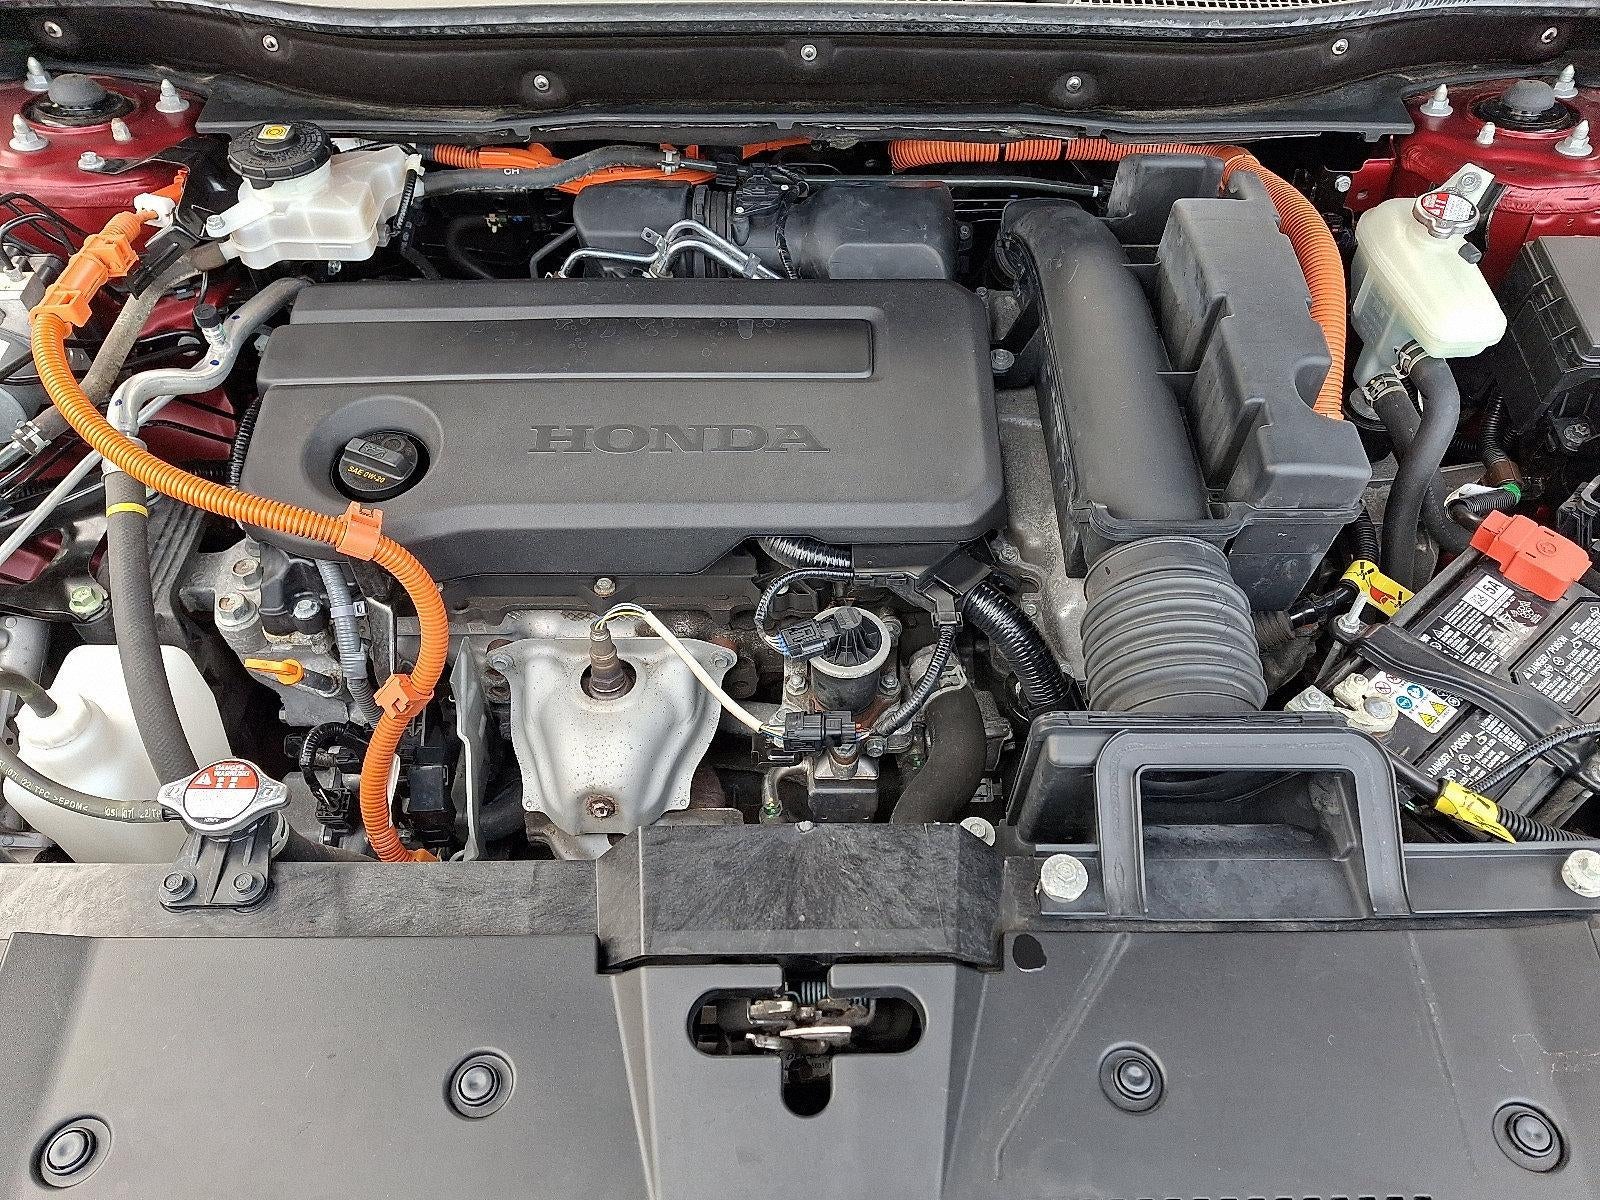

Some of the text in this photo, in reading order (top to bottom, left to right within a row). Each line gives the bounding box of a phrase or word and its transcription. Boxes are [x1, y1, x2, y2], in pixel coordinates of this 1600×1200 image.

[527, 424, 831, 454] HONDA
[347, 465, 386, 484] SAE 0W-20
[34, 785, 51, 799] TPC
